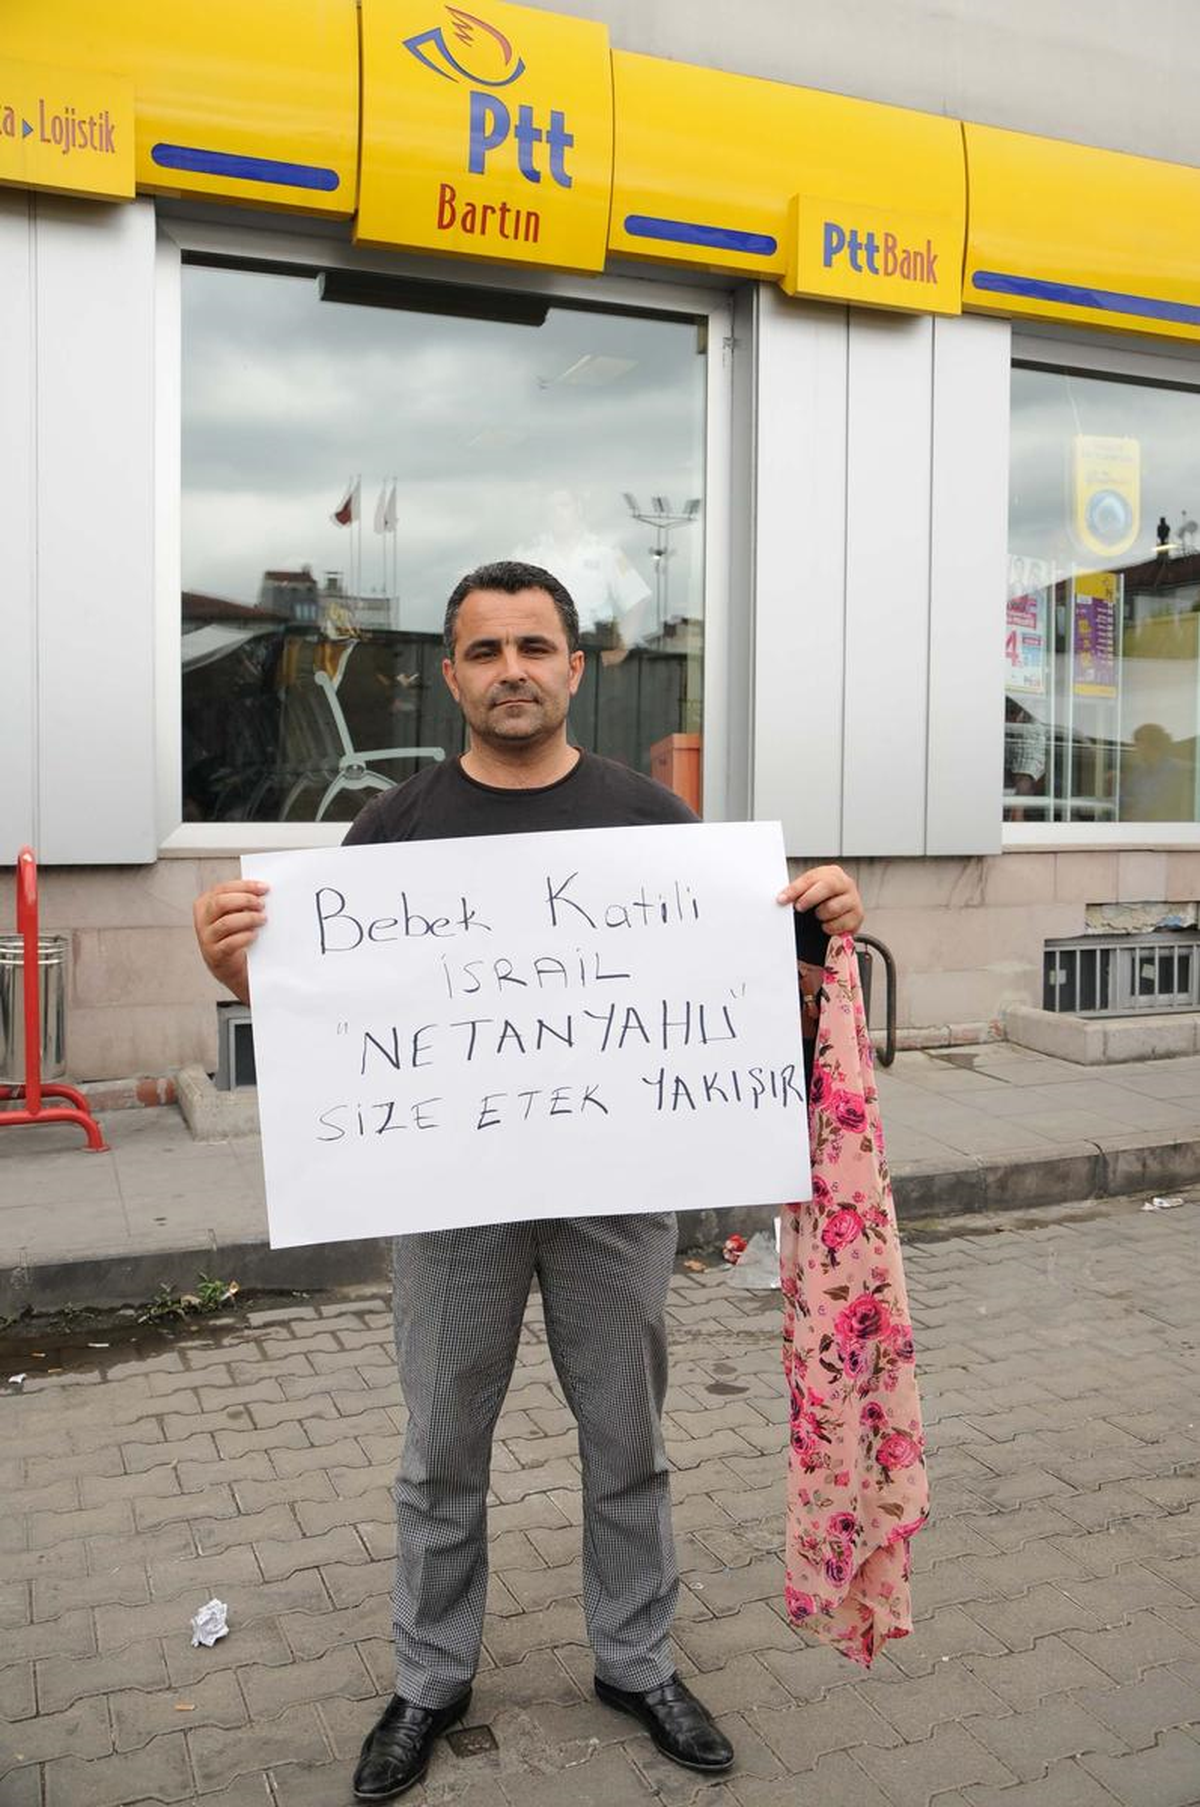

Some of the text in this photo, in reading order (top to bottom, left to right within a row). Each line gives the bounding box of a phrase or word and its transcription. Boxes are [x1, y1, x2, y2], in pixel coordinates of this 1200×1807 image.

[0, 99, 115, 155] a Lojistik
[468, 90, 574, 189] Ptt
[437, 183, 540, 243] Bartın
[823, 222, 938, 284] PttBank
[315, 872, 698, 954] Bebek Katili
[477, 1084, 608, 1130] ETEK
